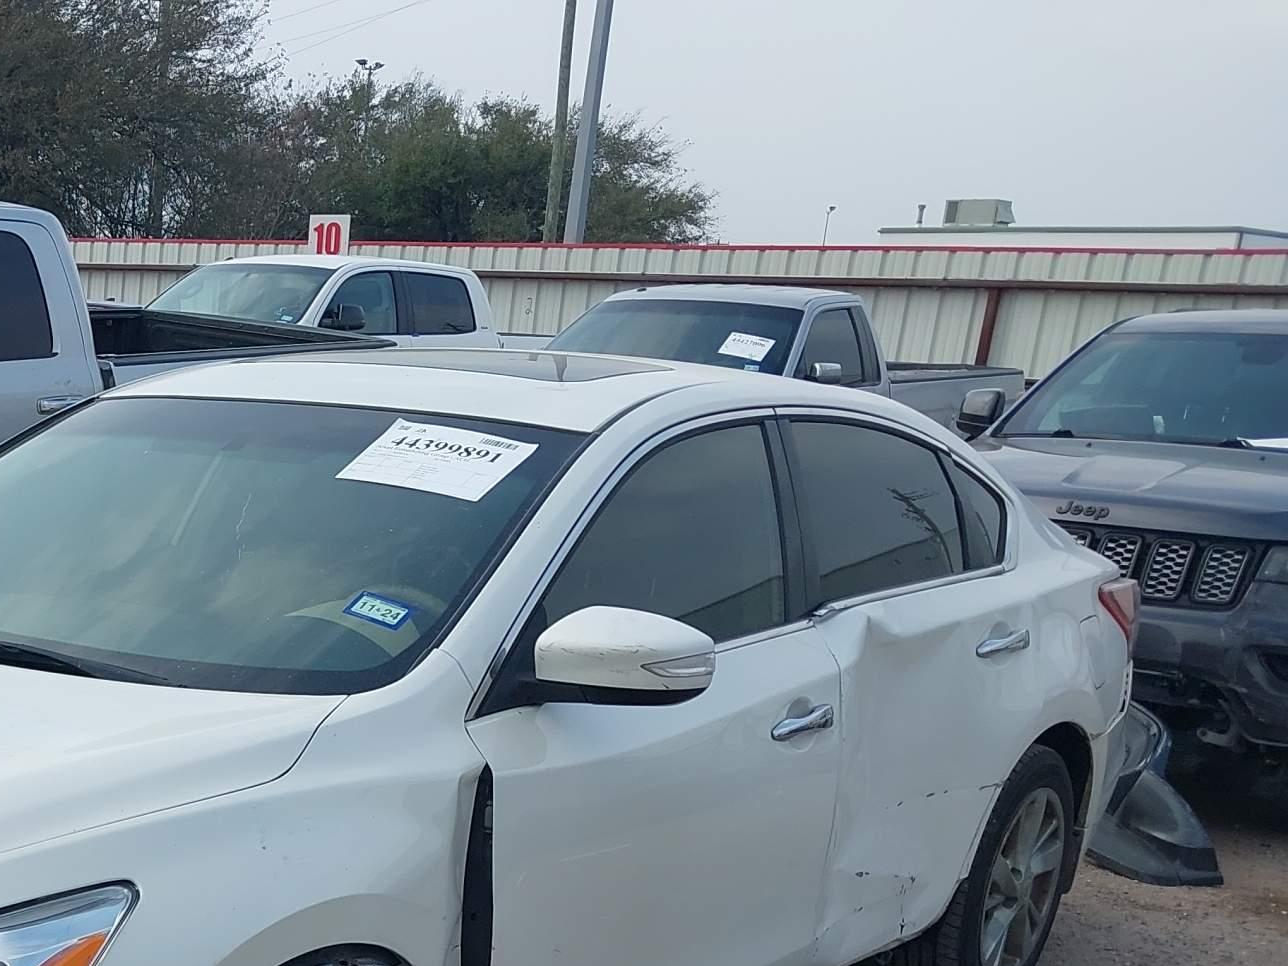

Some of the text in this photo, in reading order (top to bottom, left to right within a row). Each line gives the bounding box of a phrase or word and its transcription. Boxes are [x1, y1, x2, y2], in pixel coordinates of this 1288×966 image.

[313, 222, 341, 255] 10
[391, 435, 503, 463] 44399891
[1055, 500, 1110, 520] Jeep
